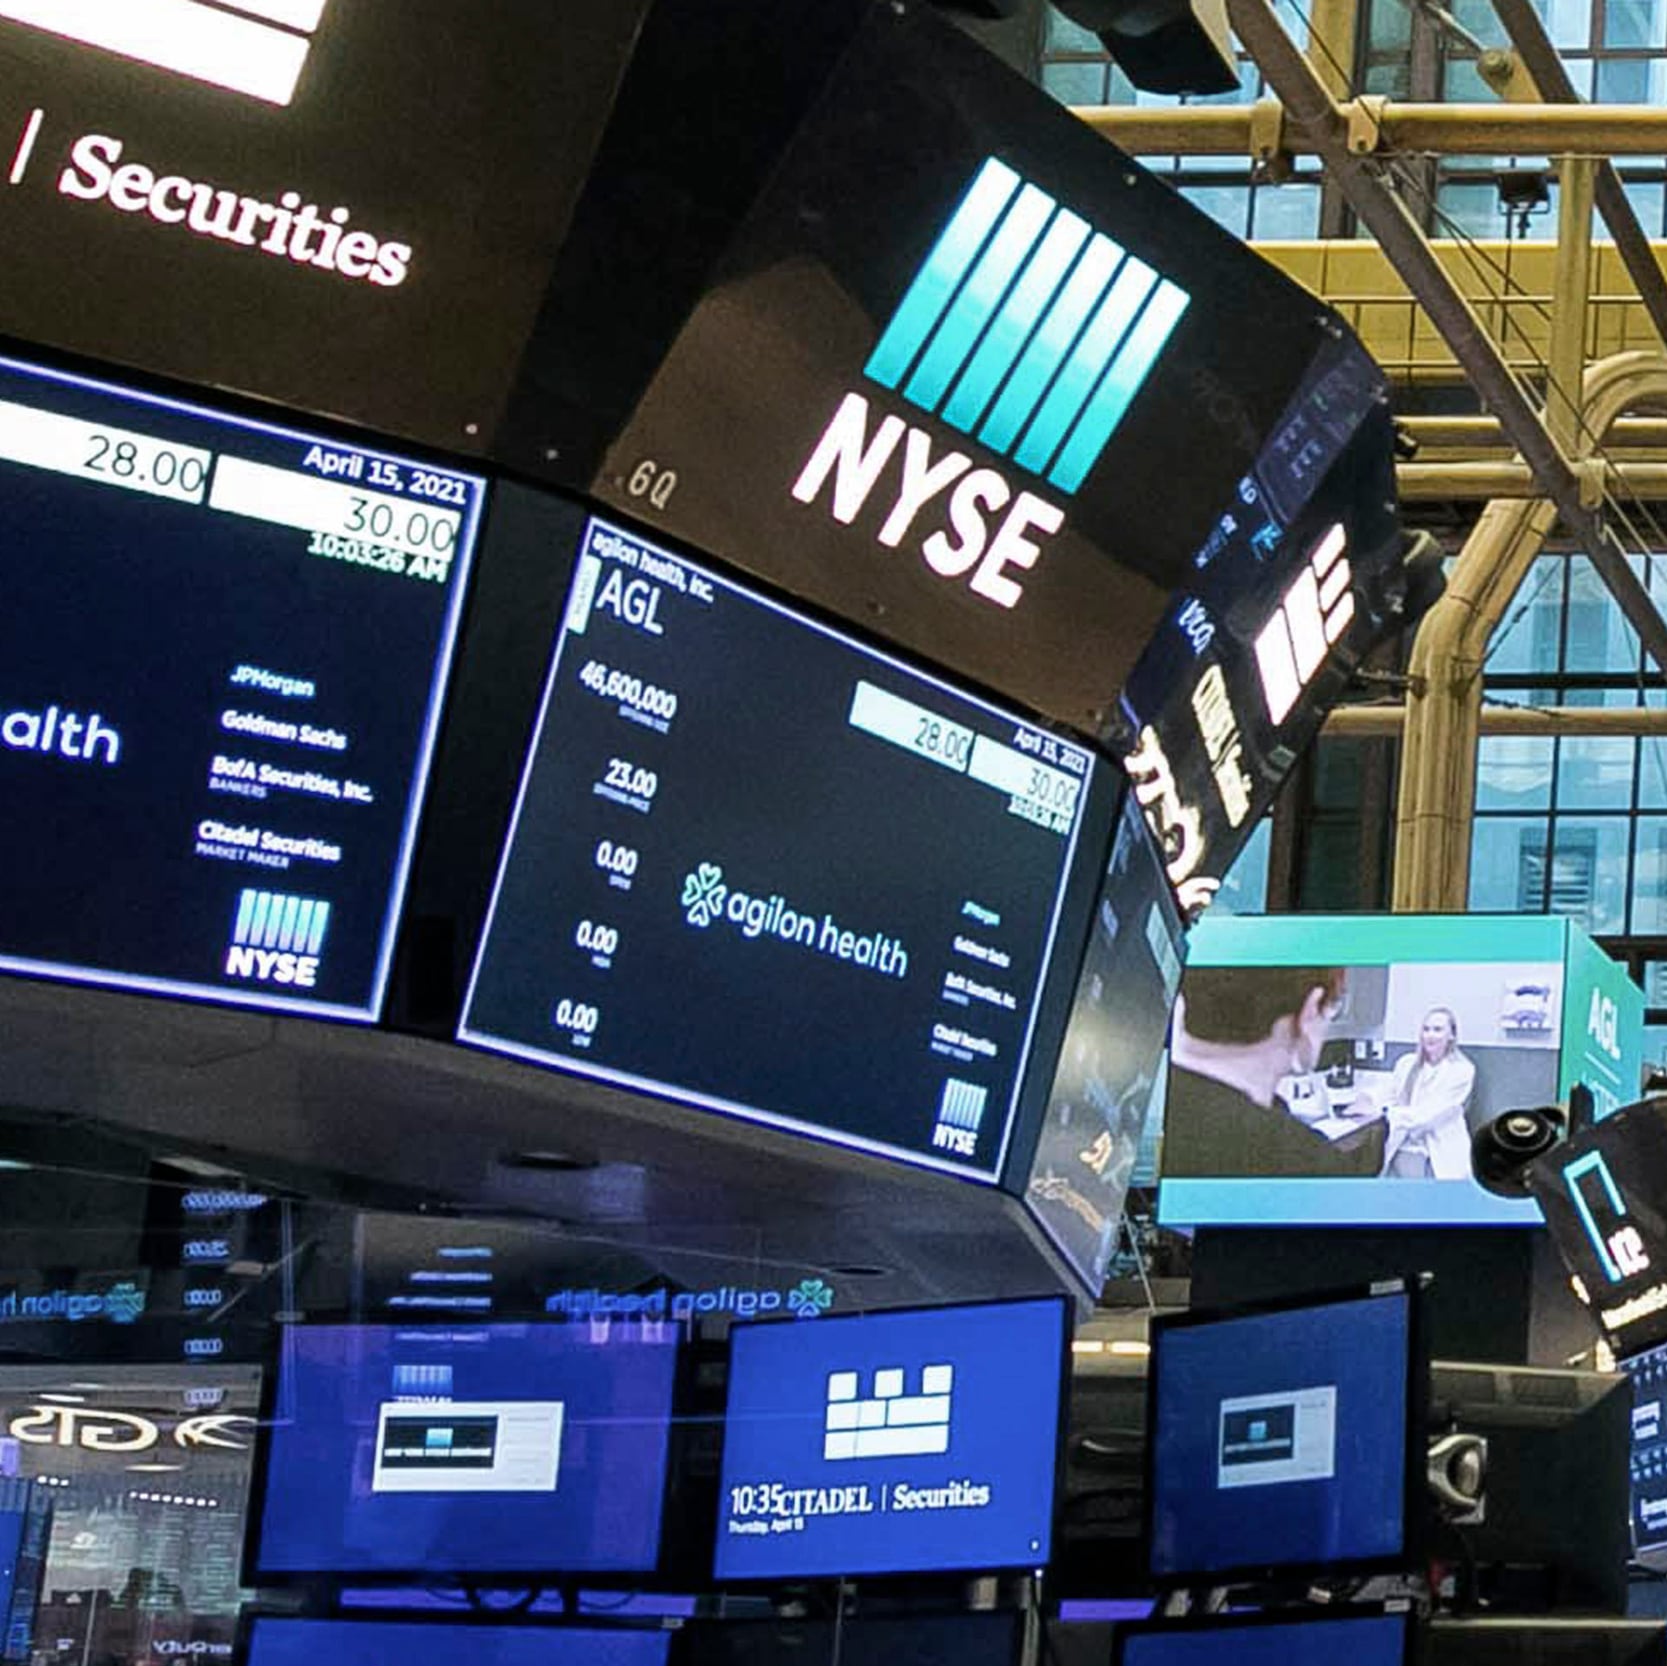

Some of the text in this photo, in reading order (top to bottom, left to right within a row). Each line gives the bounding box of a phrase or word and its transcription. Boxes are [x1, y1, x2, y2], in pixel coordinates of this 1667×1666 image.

[58, 134, 411, 286] Securities
[83, 434, 204, 493] 28.00
[302, 445, 467, 504] April 15, 2021
[790, 391, 1065, 609] NYSE
[343, 496, 455, 553] 30.00
[406, 554, 448, 583] AM
[591, 532, 640, 567] agilon
[595, 569, 664, 635] AGL
[230, 665, 315, 697] JPMorgan
[579, 660, 678, 719] 46,600,000
[220, 709, 348, 750] Goldman Sachs
[604, 758, 658, 798] 23.00
[198, 820, 342, 862] Citadel Securities
[596, 840, 638, 876] 0.00
[576, 919, 619, 956] 0.00
[726, 888, 818, 945] agilon
[819, 917, 909, 978] health
[225, 945, 320, 988] NYSE
[555, 998, 599, 1034] 0.00
[932, 1122, 978, 1156] NYSE
[731, 1479, 990, 1517] 10:35 CITADEL Securities
